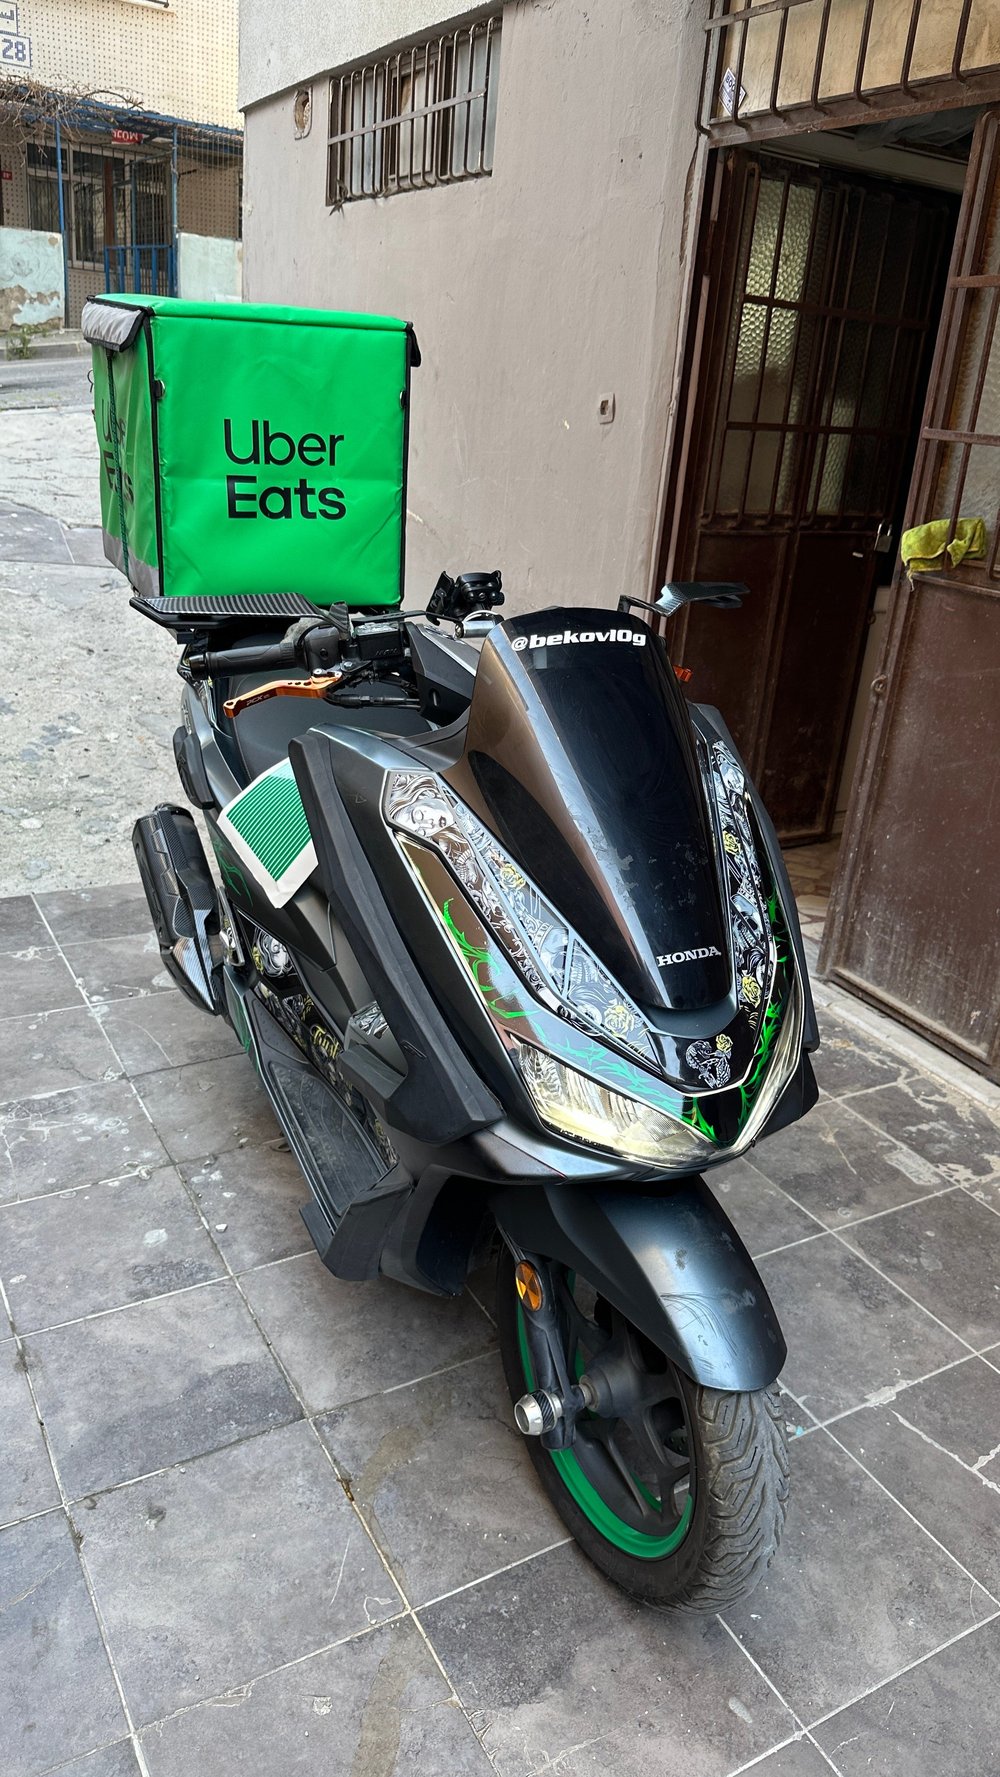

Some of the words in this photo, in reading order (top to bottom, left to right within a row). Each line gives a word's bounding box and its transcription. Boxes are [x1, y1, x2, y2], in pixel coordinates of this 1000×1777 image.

[2, 38, 26, 62] 28
[224, 418, 344, 467] Uber
[226, 475, 346, 521] Eats
[656, 946, 721, 967] HONDA
